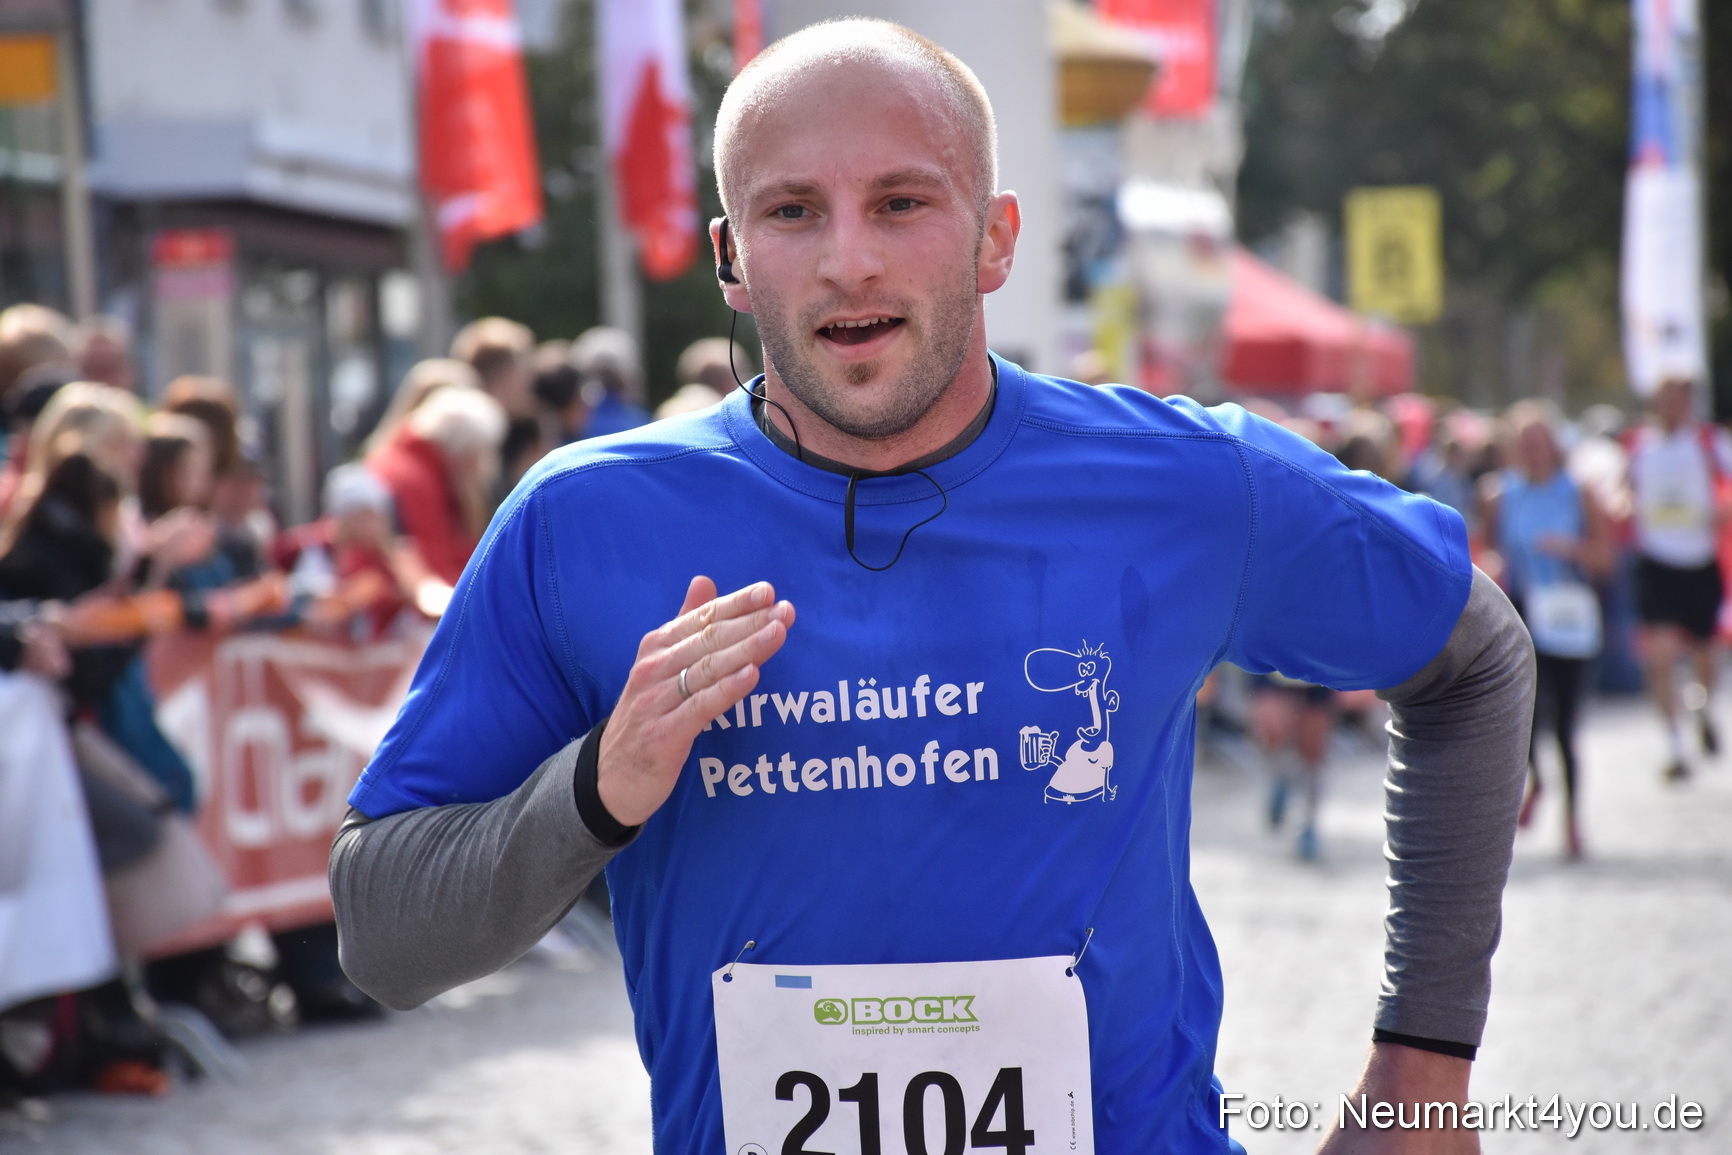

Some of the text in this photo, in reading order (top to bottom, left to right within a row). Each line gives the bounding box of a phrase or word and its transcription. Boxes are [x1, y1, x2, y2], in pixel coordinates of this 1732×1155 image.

[699, 740, 999, 798] Pettenhofen
[851, 995, 979, 1025] BOCK
[852, 1024, 981, 1037] inspired by smart concepts
[775, 1067, 1035, 1155] 2104
